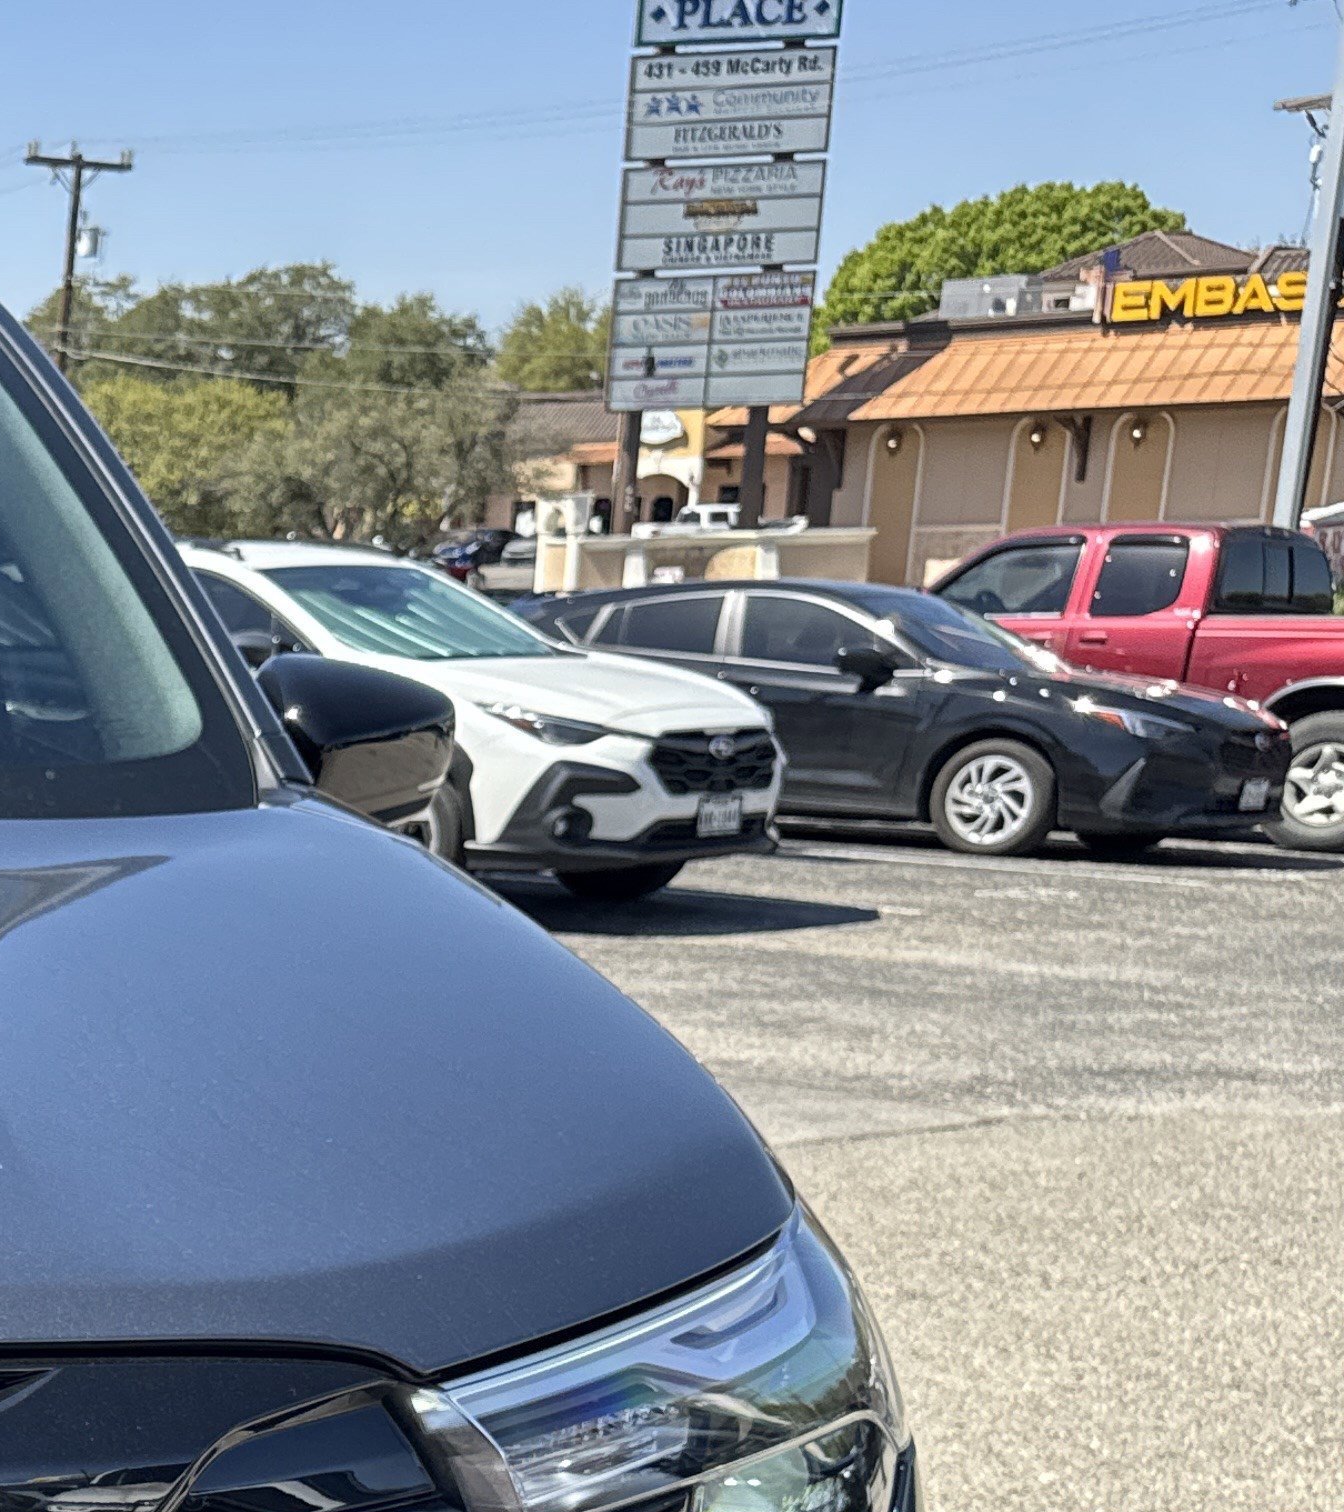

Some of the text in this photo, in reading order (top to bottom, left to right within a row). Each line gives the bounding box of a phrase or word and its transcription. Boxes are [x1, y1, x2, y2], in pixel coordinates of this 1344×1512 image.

[672, 0, 808, 31] PLACE
[726, 55, 793, 76] McCarty
[797, 54, 824, 73] Rd.
[713, 88, 820, 107] Community
[673, 122, 783, 144] FITZGERALD'S
[663, 233, 775, 254] SINGAPORE
[1112, 270, 1308, 323] EMBAS
